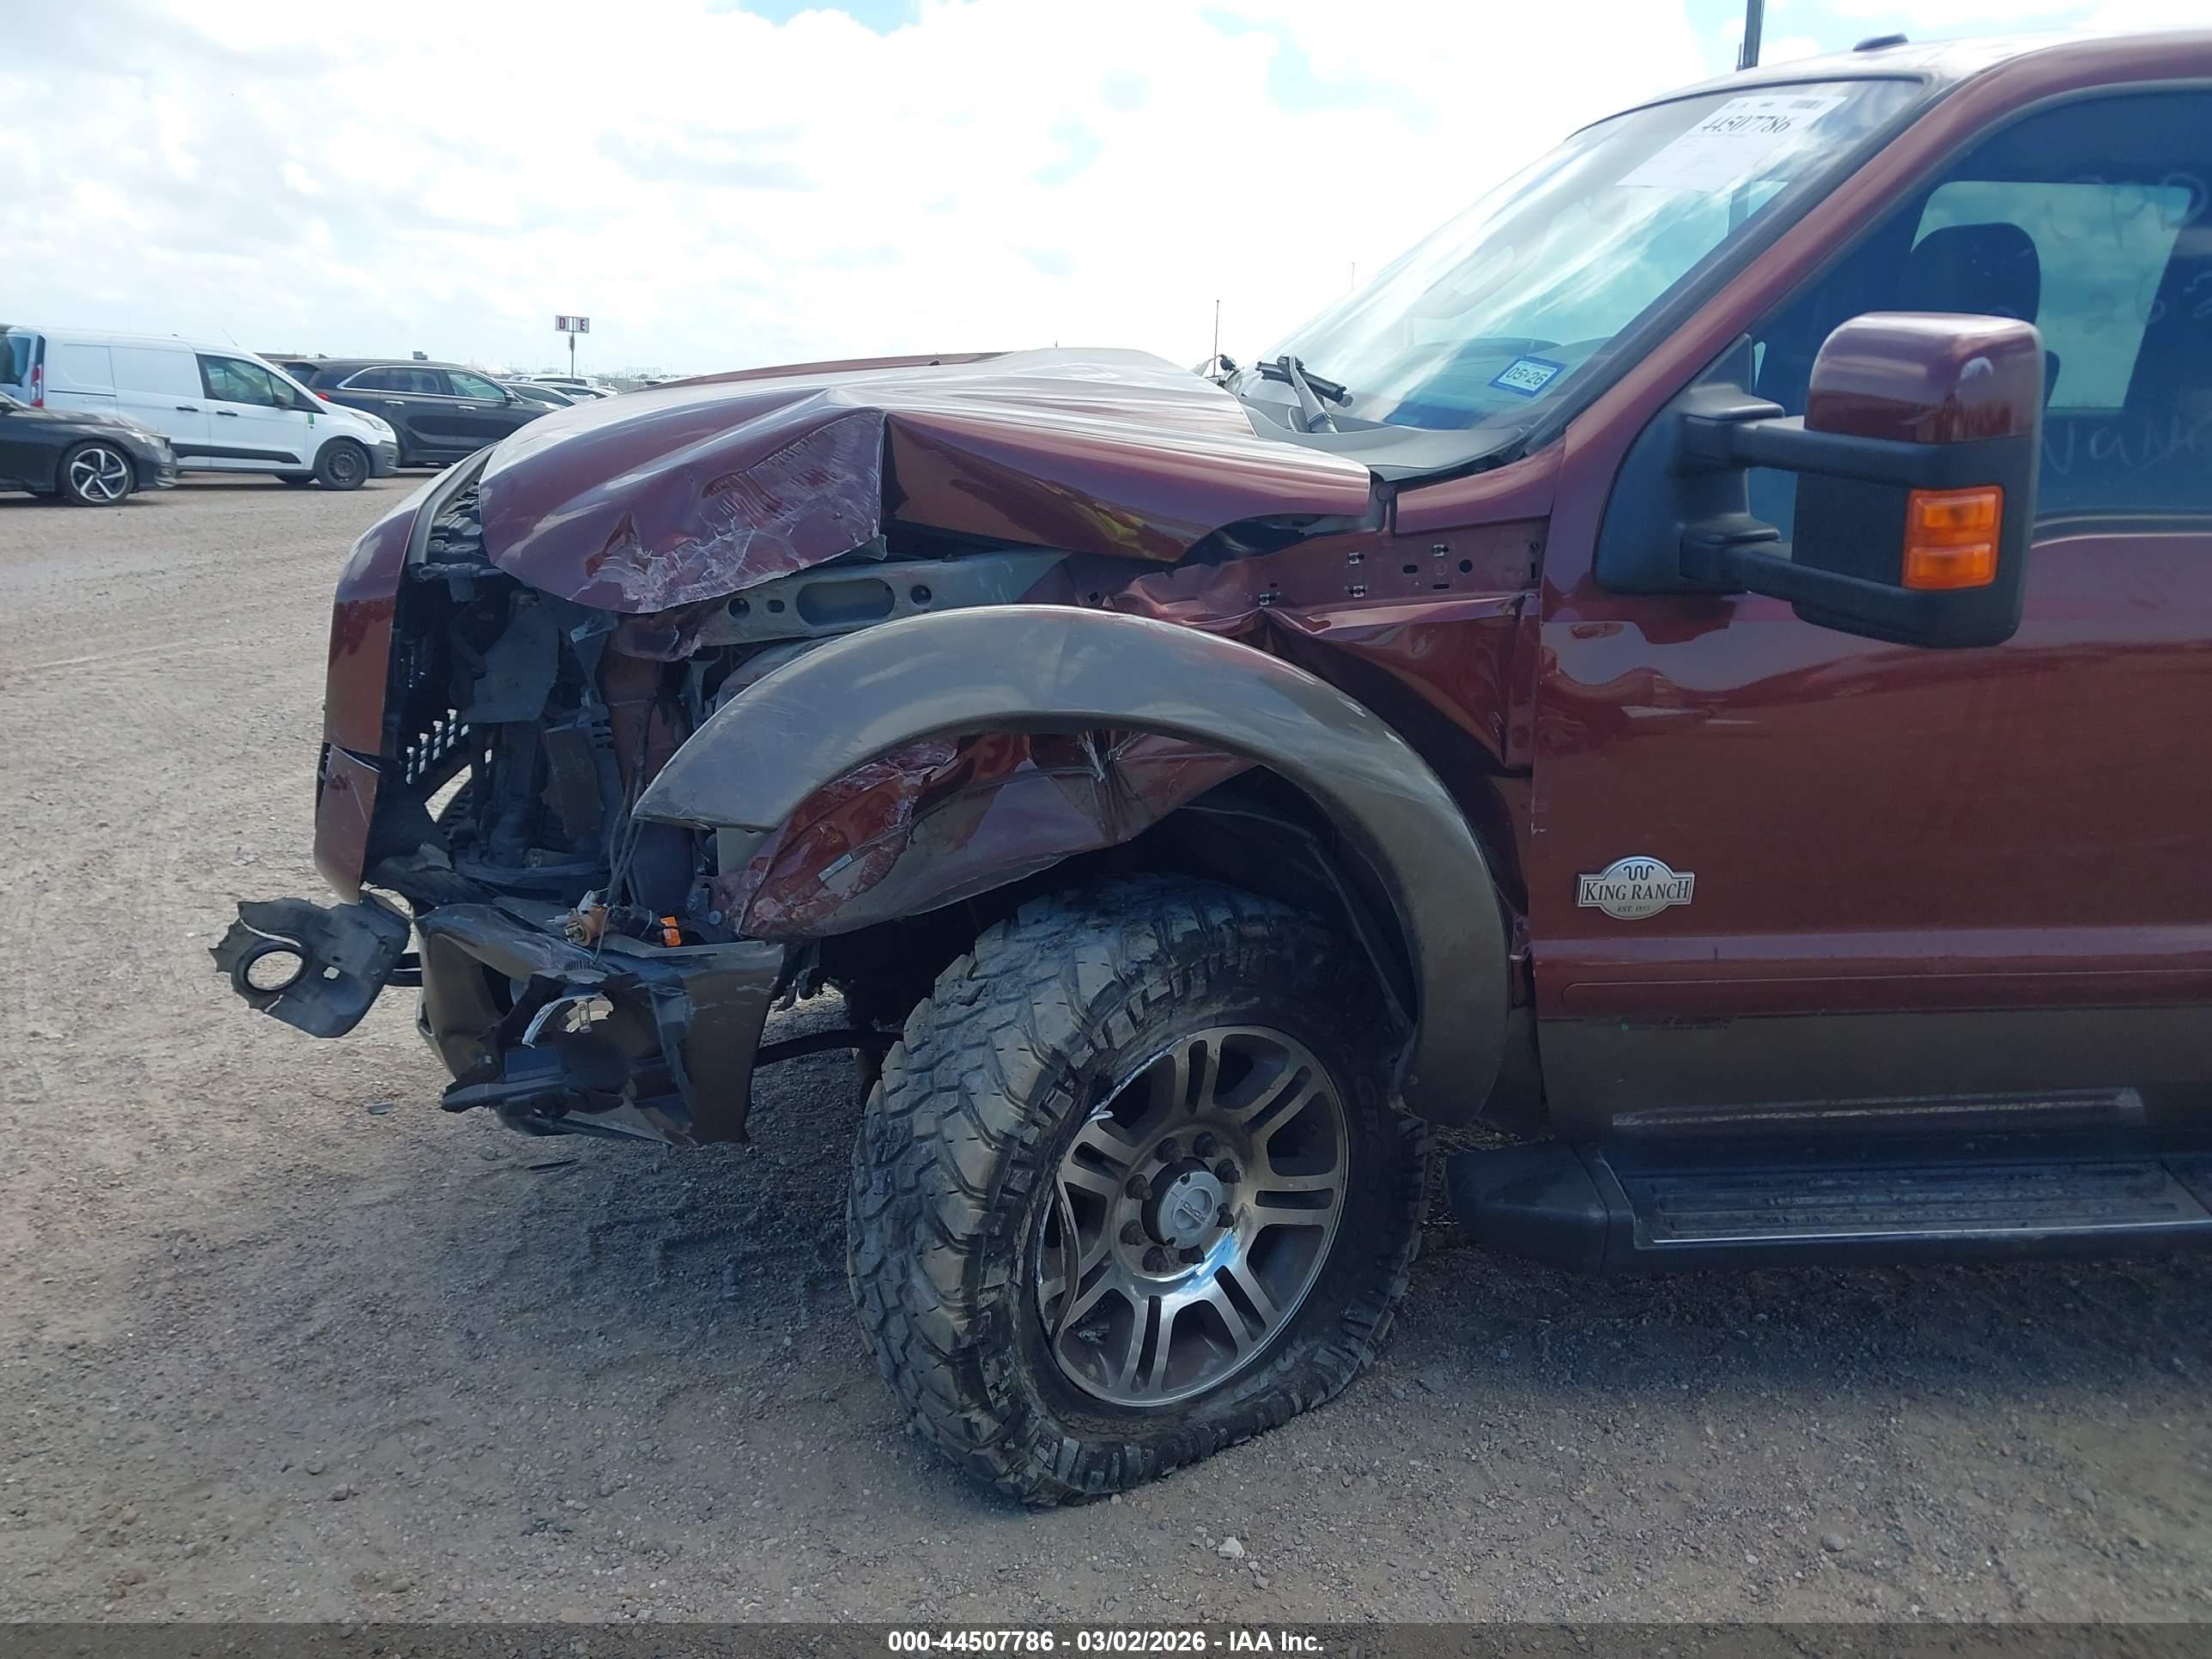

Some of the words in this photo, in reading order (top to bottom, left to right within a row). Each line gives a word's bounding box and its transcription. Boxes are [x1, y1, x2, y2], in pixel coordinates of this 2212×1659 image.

[1701, 115, 1796, 133] 44507786
[1584, 882, 1626, 901] KING
[1632, 880, 1690, 900] RANCH
